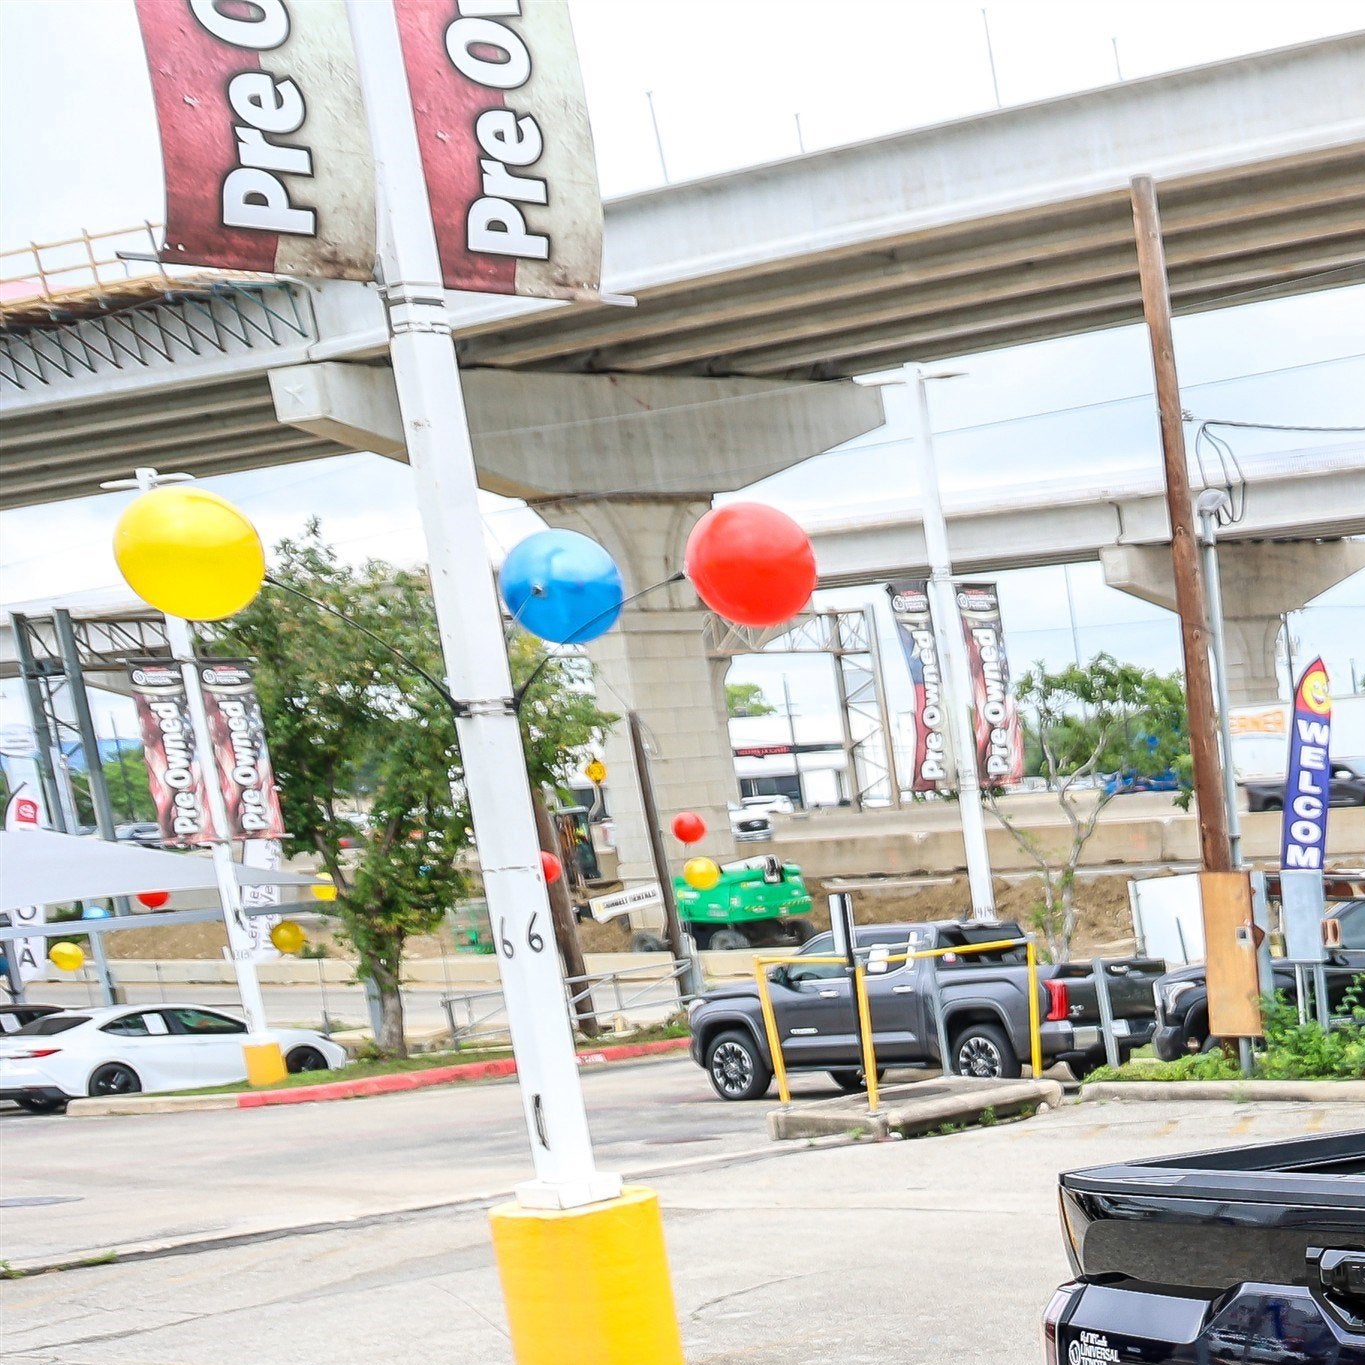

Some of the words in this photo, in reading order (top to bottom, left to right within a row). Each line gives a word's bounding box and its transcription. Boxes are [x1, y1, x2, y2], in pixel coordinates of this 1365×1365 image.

[222, 70, 318, 237] Pre
[466, 108, 551, 260] Pre
[911, 630, 942, 729] Owned
[971, 628, 1007, 726] Owned
[149, 701, 194, 789] Owned
[217, 700, 260, 787] Owned
[921, 731, 947, 780] Pre
[987, 727, 1012, 776] Pre
[173, 790, 202, 834] Pre
[240, 788, 269, 831] Pre
[1286, 719, 1330, 869] WELCOM
[1081, 1343, 1120, 1362] UNIVERSAL
